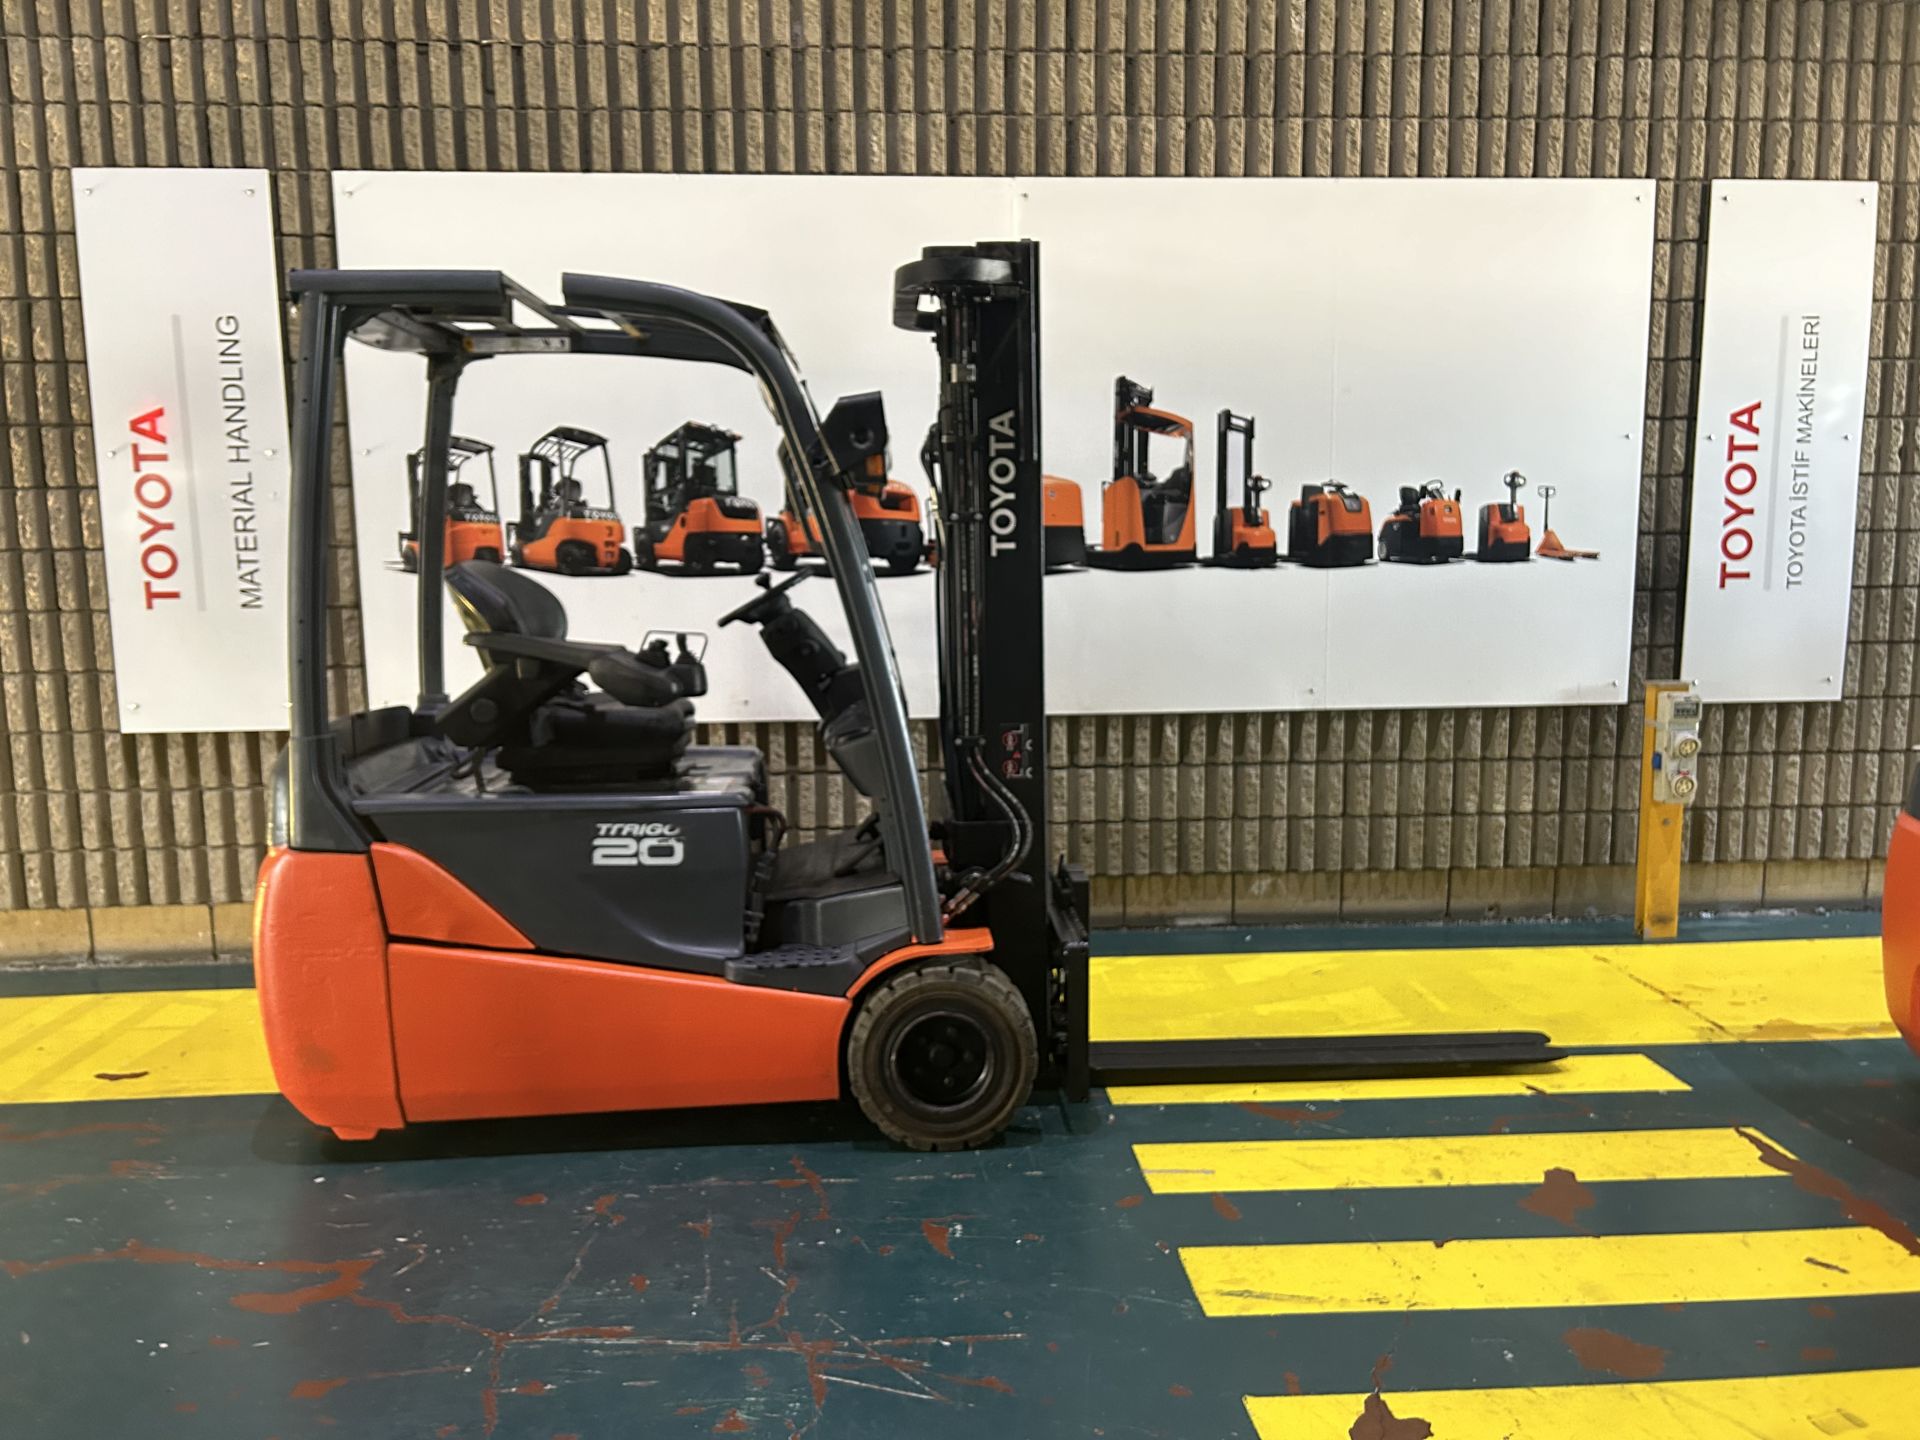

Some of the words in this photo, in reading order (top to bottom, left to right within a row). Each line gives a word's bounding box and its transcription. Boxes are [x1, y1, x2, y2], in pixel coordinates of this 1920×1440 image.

[215, 314, 252, 464] HANDLING
[1795, 315, 1821, 444] MAKİNELERİ
[128, 406, 181, 610] TOYOTA
[230, 471, 262, 609] MATERIAL
[988, 409, 1018, 558] TOYOTA
[1719, 400, 1762, 589] TOYOTA
[1788, 449, 1812, 502] İSTİF
[1785, 505, 1808, 590] TOYOTA
[592, 836, 685, 866] 20
